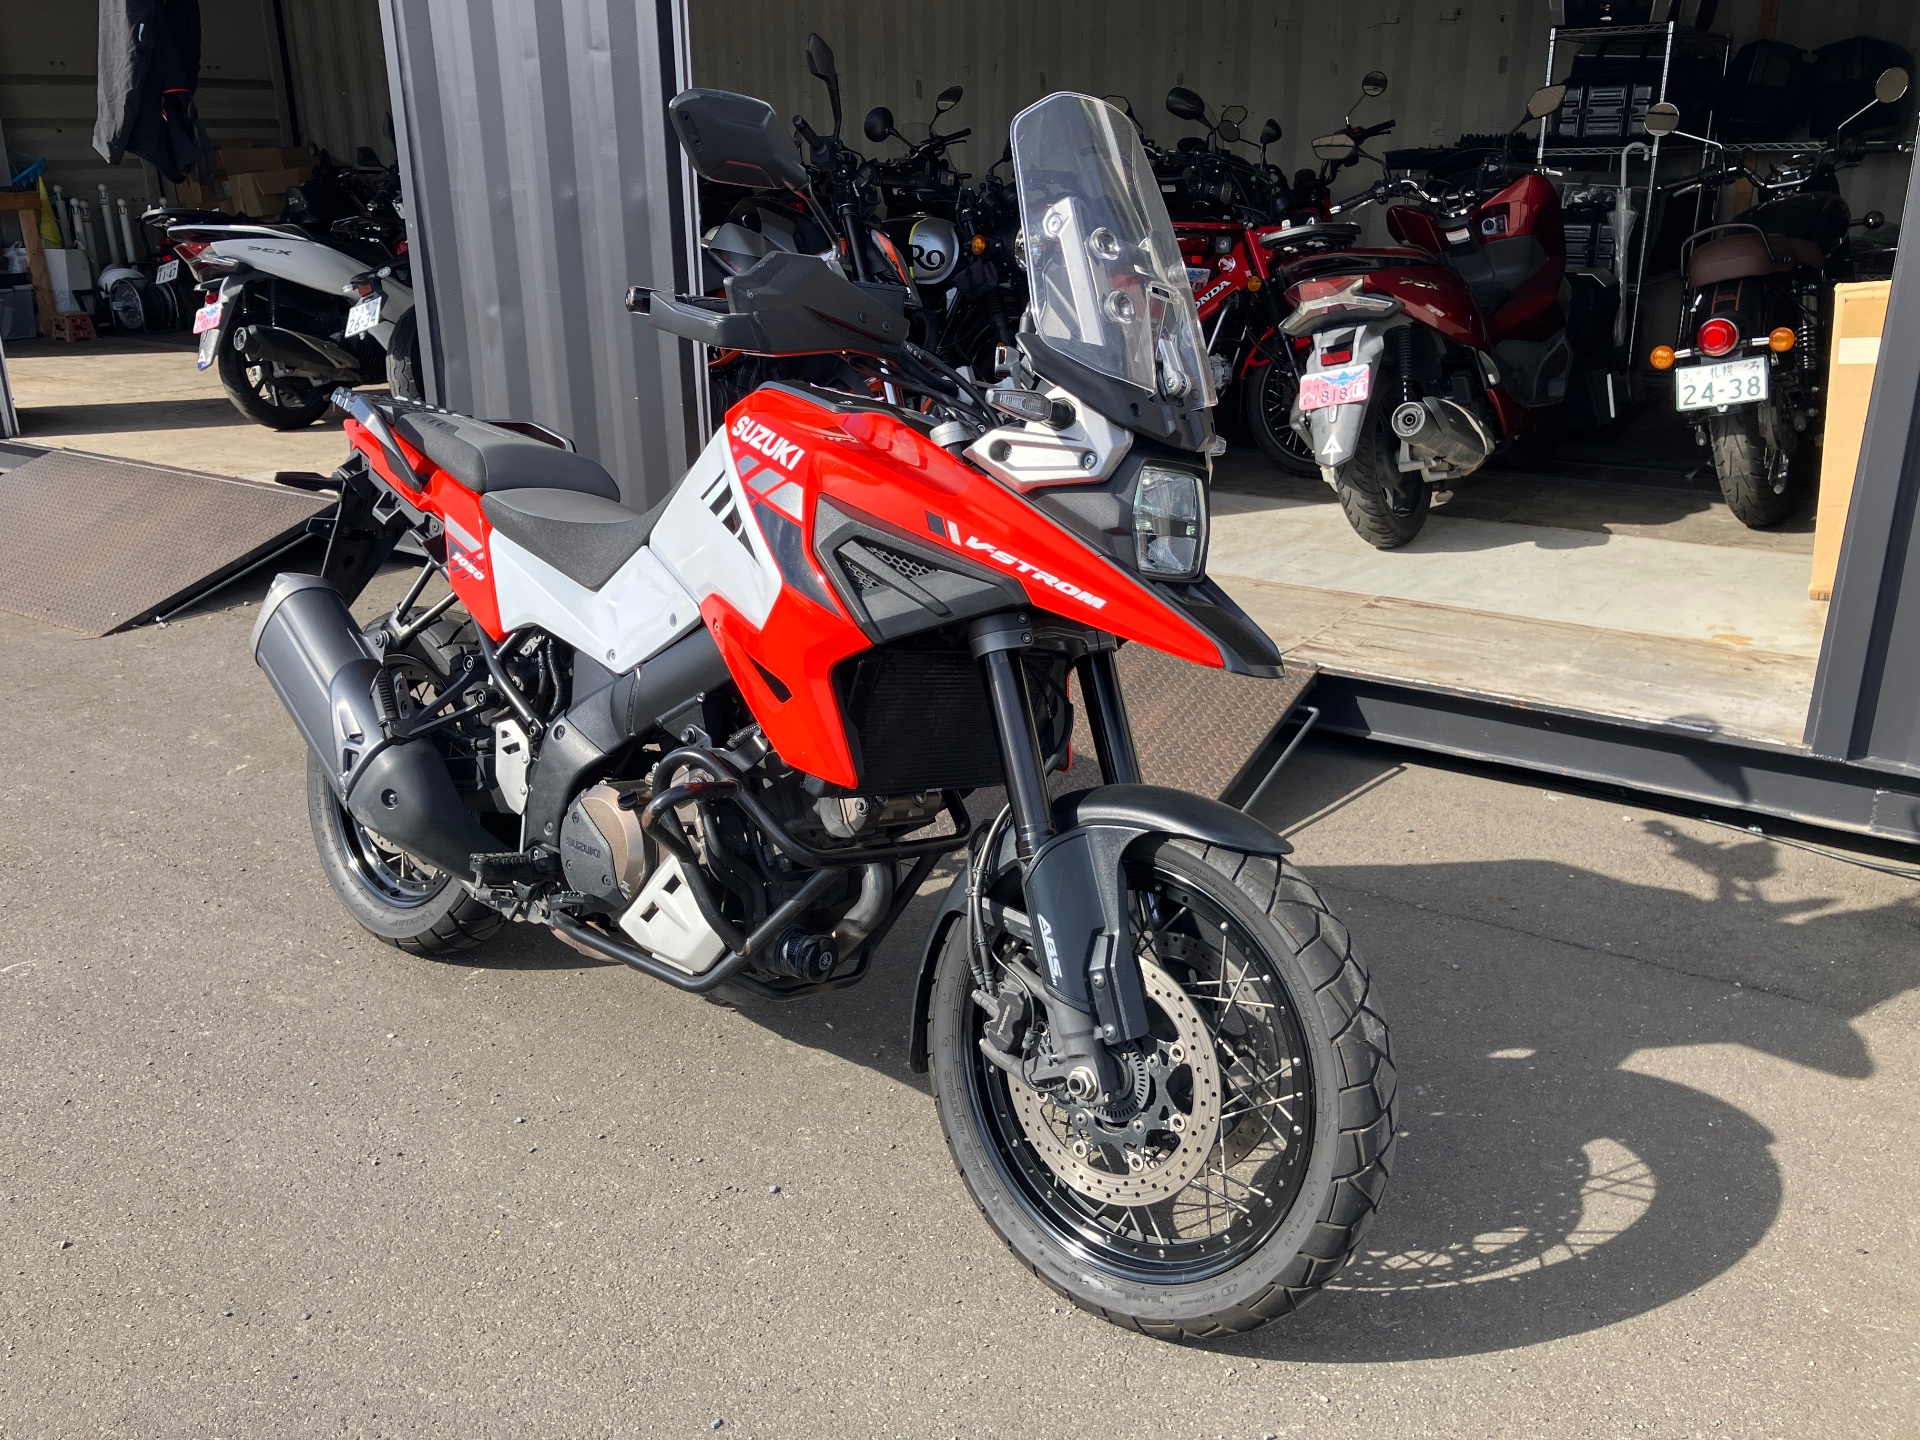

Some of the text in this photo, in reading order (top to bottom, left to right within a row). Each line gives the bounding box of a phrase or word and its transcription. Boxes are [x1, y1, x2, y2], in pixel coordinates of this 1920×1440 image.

[1195, 280, 1231, 309] ONDA
[348, 310, 377, 334] 26-34
[1683, 376, 1761, 406] 24-38
[731, 415, 806, 471] SUZUKI
[451, 551, 485, 581] 1050
[965, 535, 1107, 610] V-STROM
[565, 836, 601, 859] SUZUKI
[1036, 912, 1063, 979] ABS
